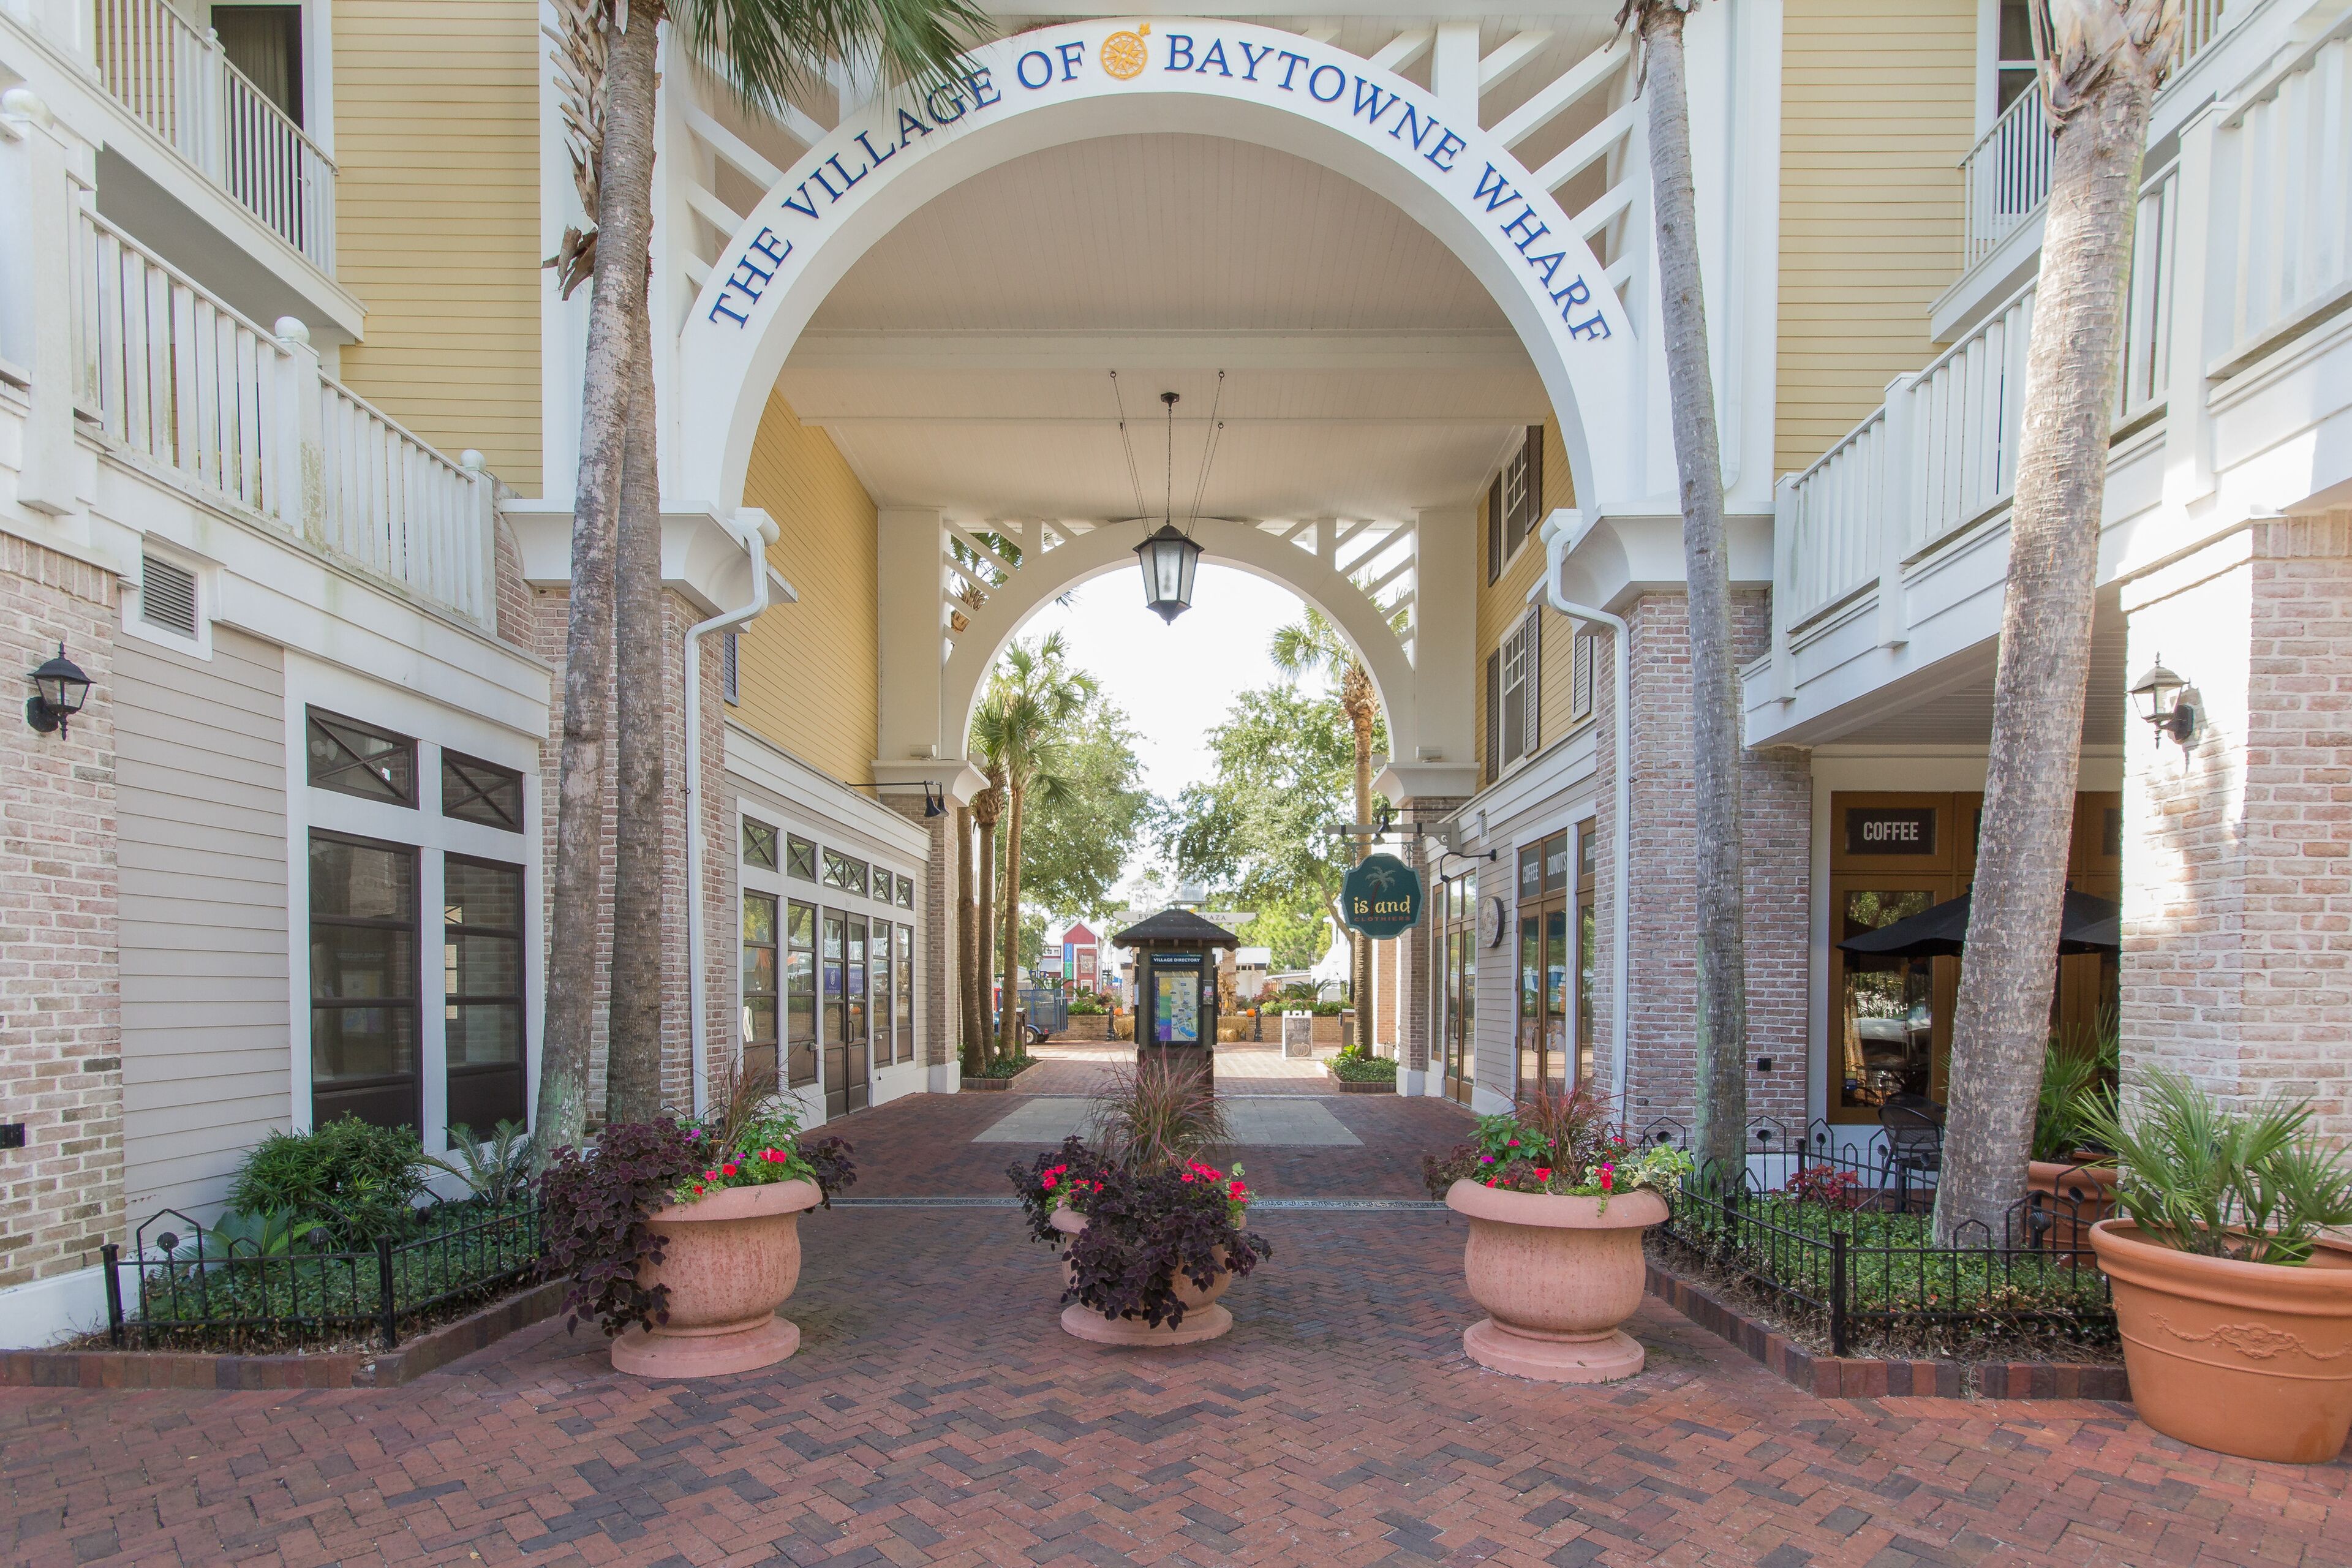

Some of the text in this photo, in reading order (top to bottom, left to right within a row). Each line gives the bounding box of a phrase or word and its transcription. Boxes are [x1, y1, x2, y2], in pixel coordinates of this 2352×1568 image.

[709, 34, 1612, 341] THE VILLAGE OF BAYTOWNE WHARF
[1863, 821, 1918, 840] COFFEE
[1523, 861, 1539, 884] COFFEE
[1547, 851, 1567, 876] DONUTS
